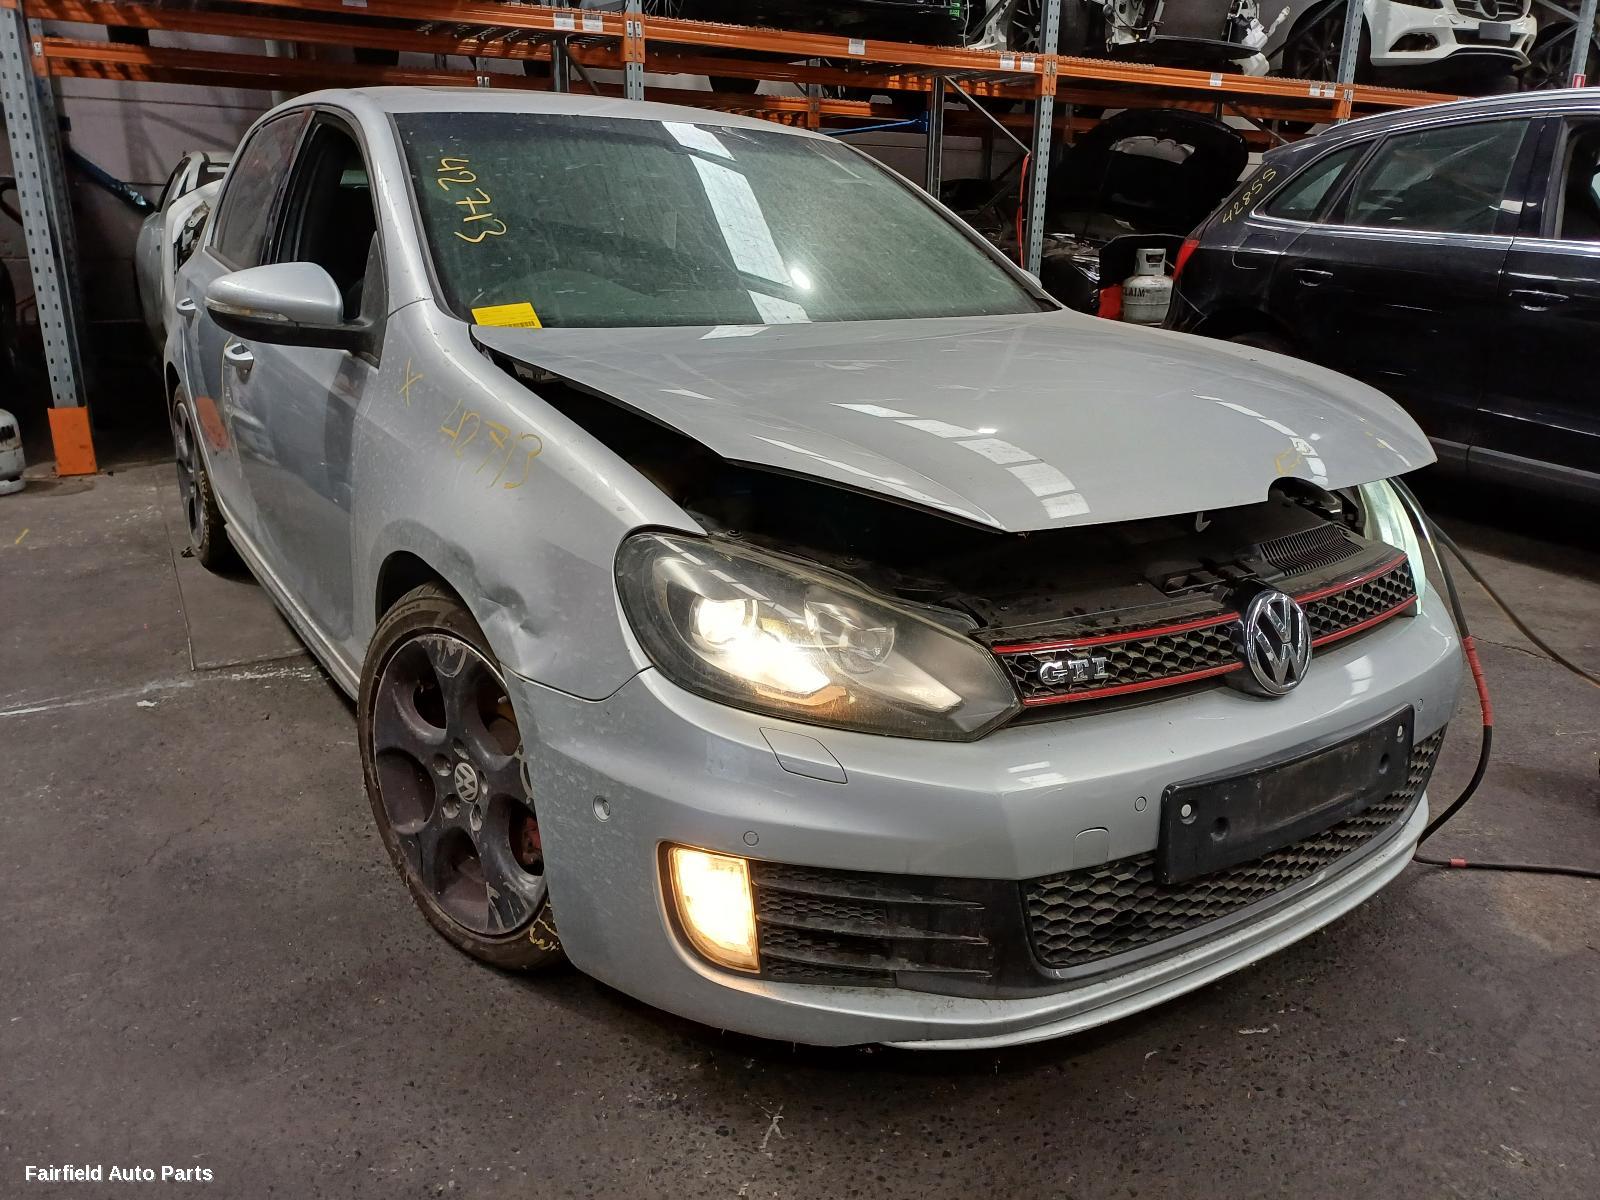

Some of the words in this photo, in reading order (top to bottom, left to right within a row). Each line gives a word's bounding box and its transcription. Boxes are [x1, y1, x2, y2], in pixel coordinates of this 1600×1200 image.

[436, 157, 508, 243] 42713
[1222, 168, 1277, 224] 42855
[1039, 655, 1109, 685] GTI
